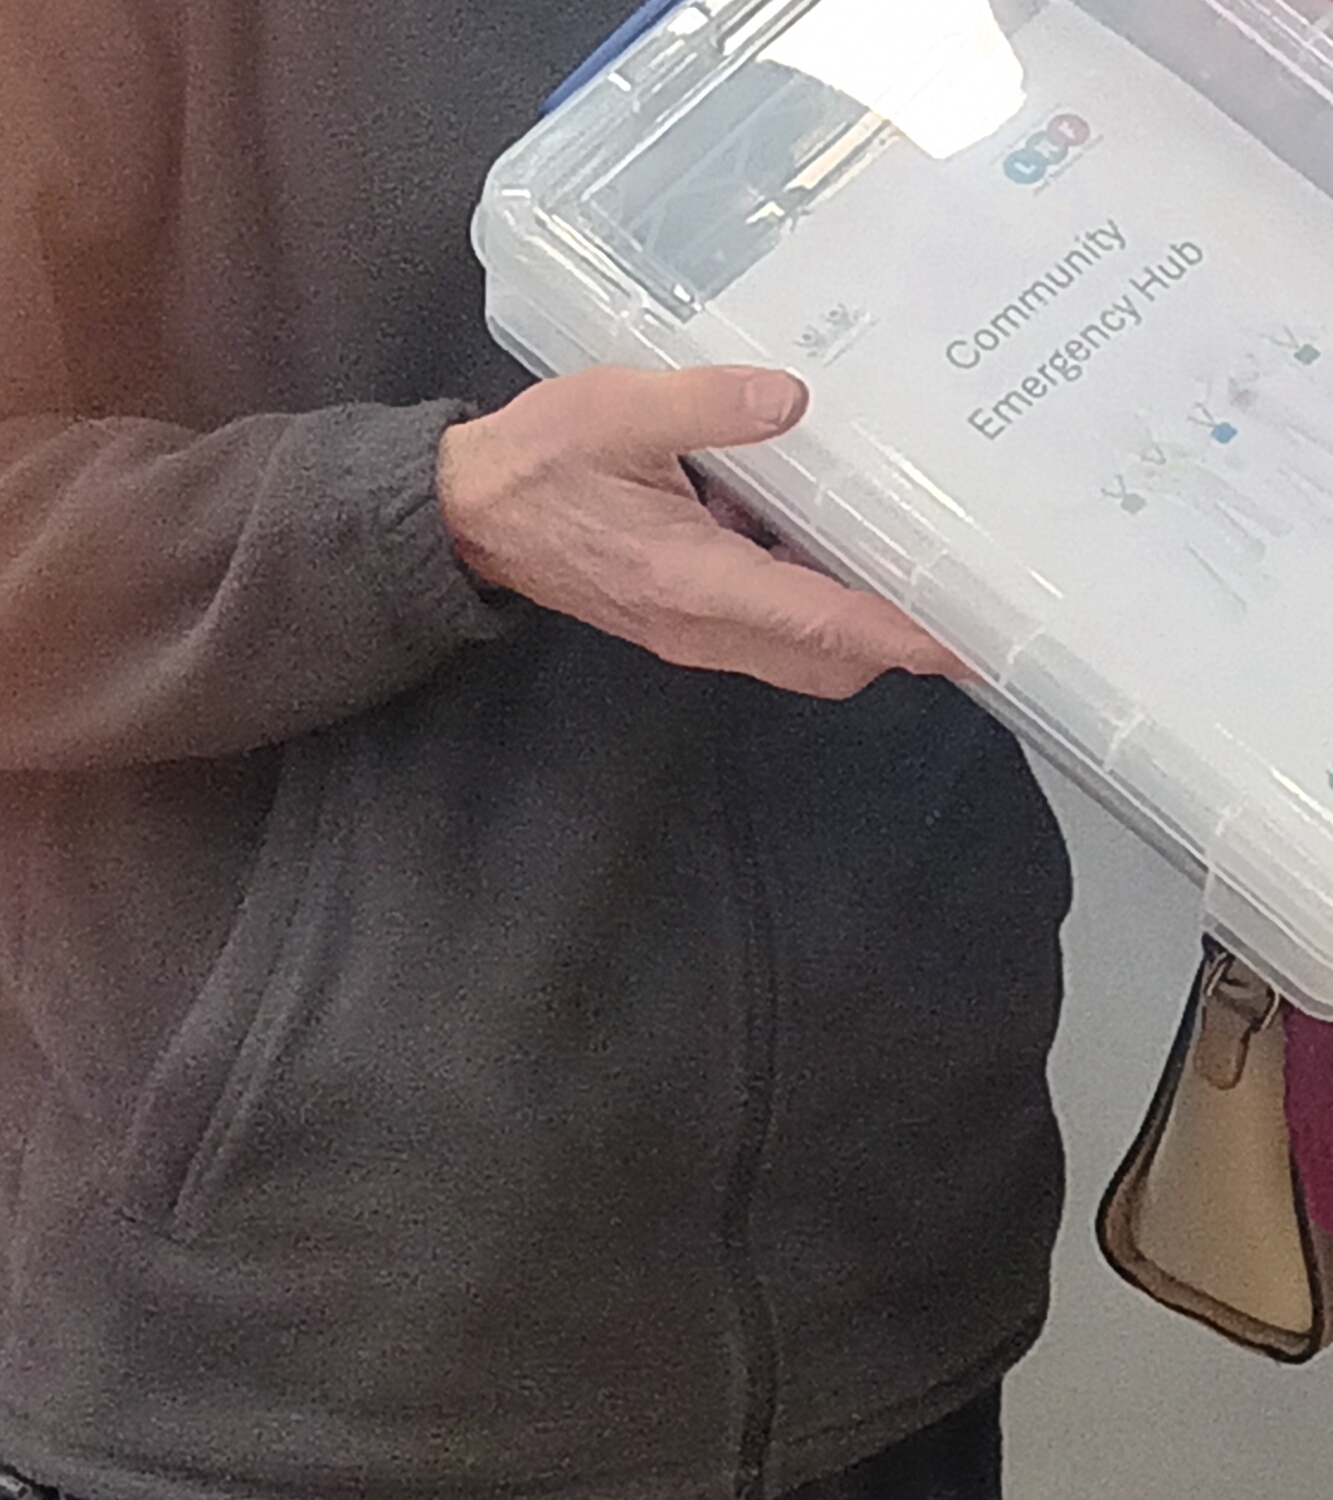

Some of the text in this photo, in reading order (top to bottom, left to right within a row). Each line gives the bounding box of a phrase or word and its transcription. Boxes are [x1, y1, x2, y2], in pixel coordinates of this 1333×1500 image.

[945, 218, 1127, 370] Community
[966, 294, 1142, 440] Emergency
[1128, 240, 1204, 302] Hub
